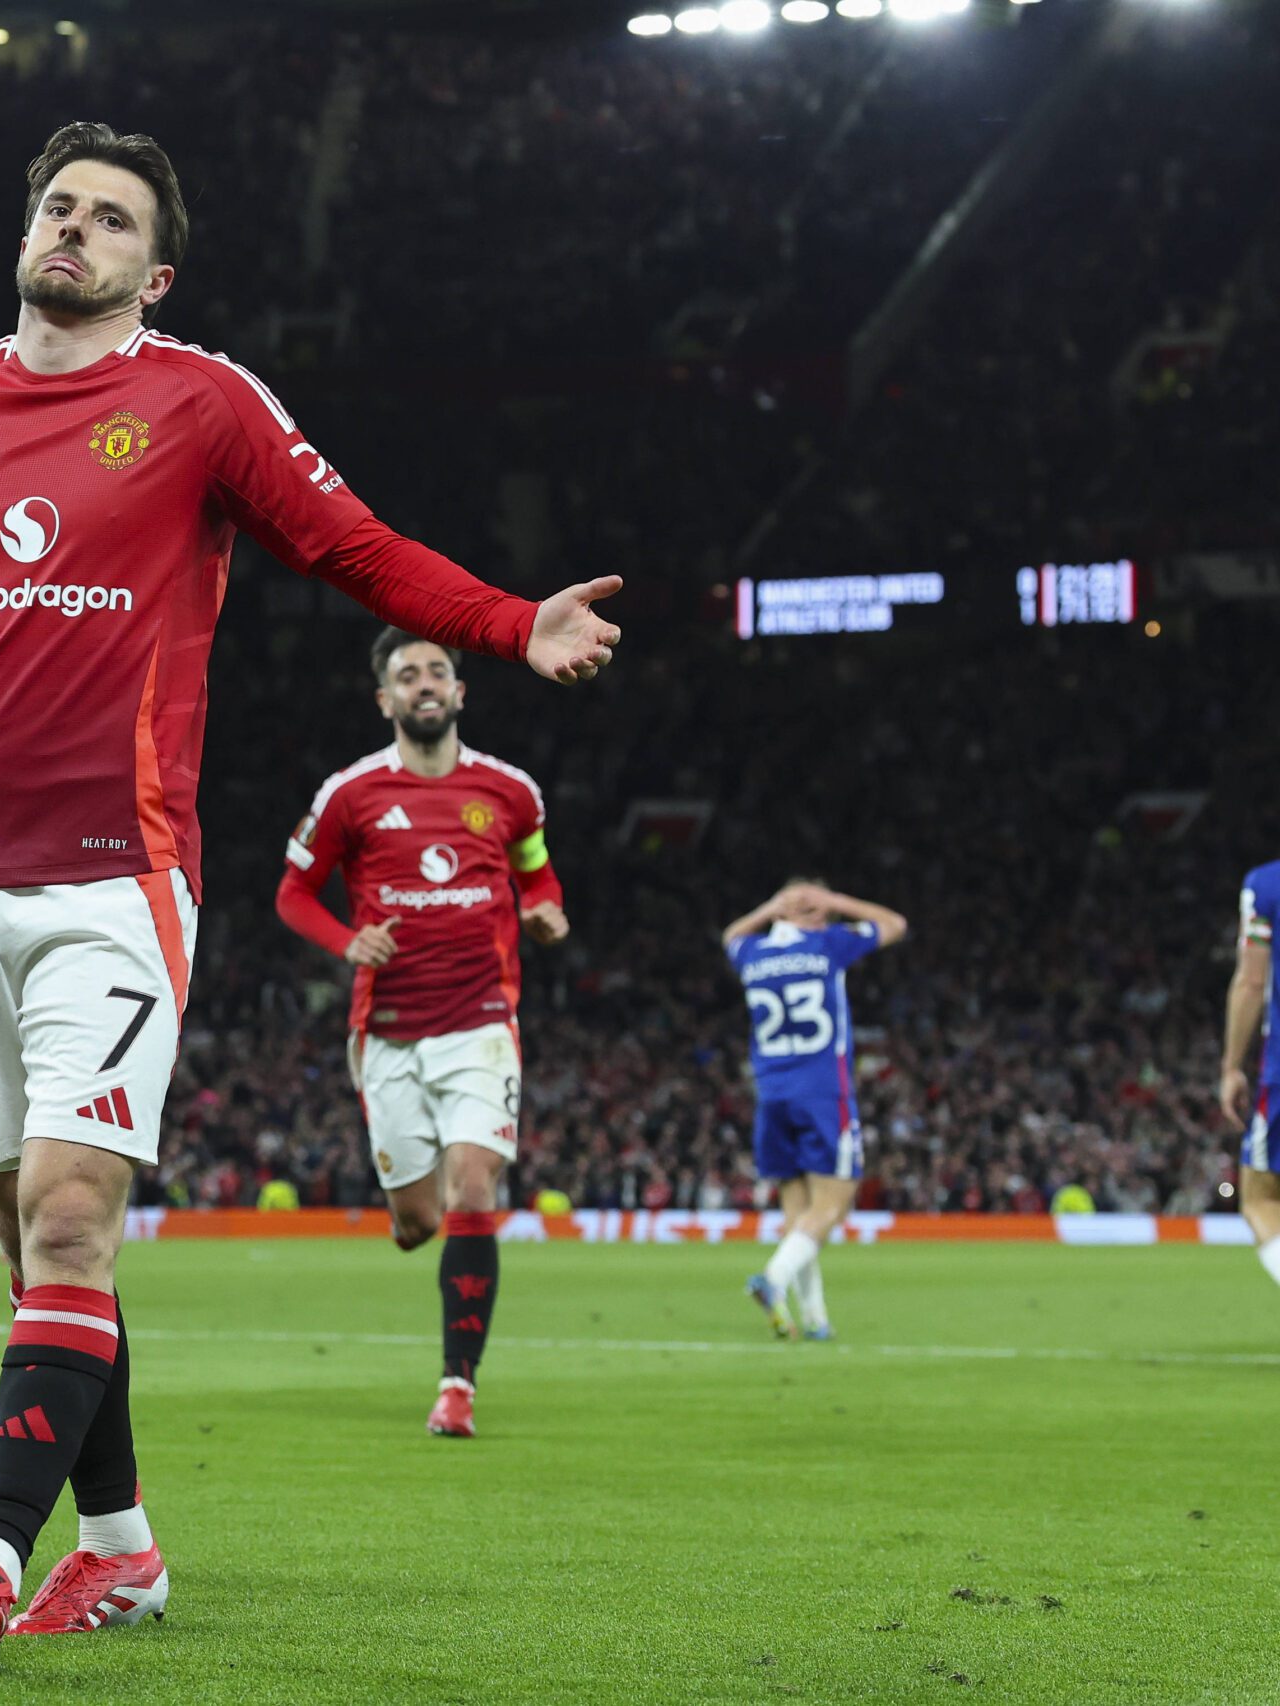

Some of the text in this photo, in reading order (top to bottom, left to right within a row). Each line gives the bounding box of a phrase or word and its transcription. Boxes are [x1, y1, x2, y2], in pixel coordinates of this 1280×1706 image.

[97, 416, 145, 435] MANCHESTER
[100, 456, 134, 466] UNITED
[81, 837, 128, 850] HEAT.RDY
[378, 885, 492, 911] Snapdragon
[745, 978, 834, 1057] 23
[95, 985, 160, 1075] 7
